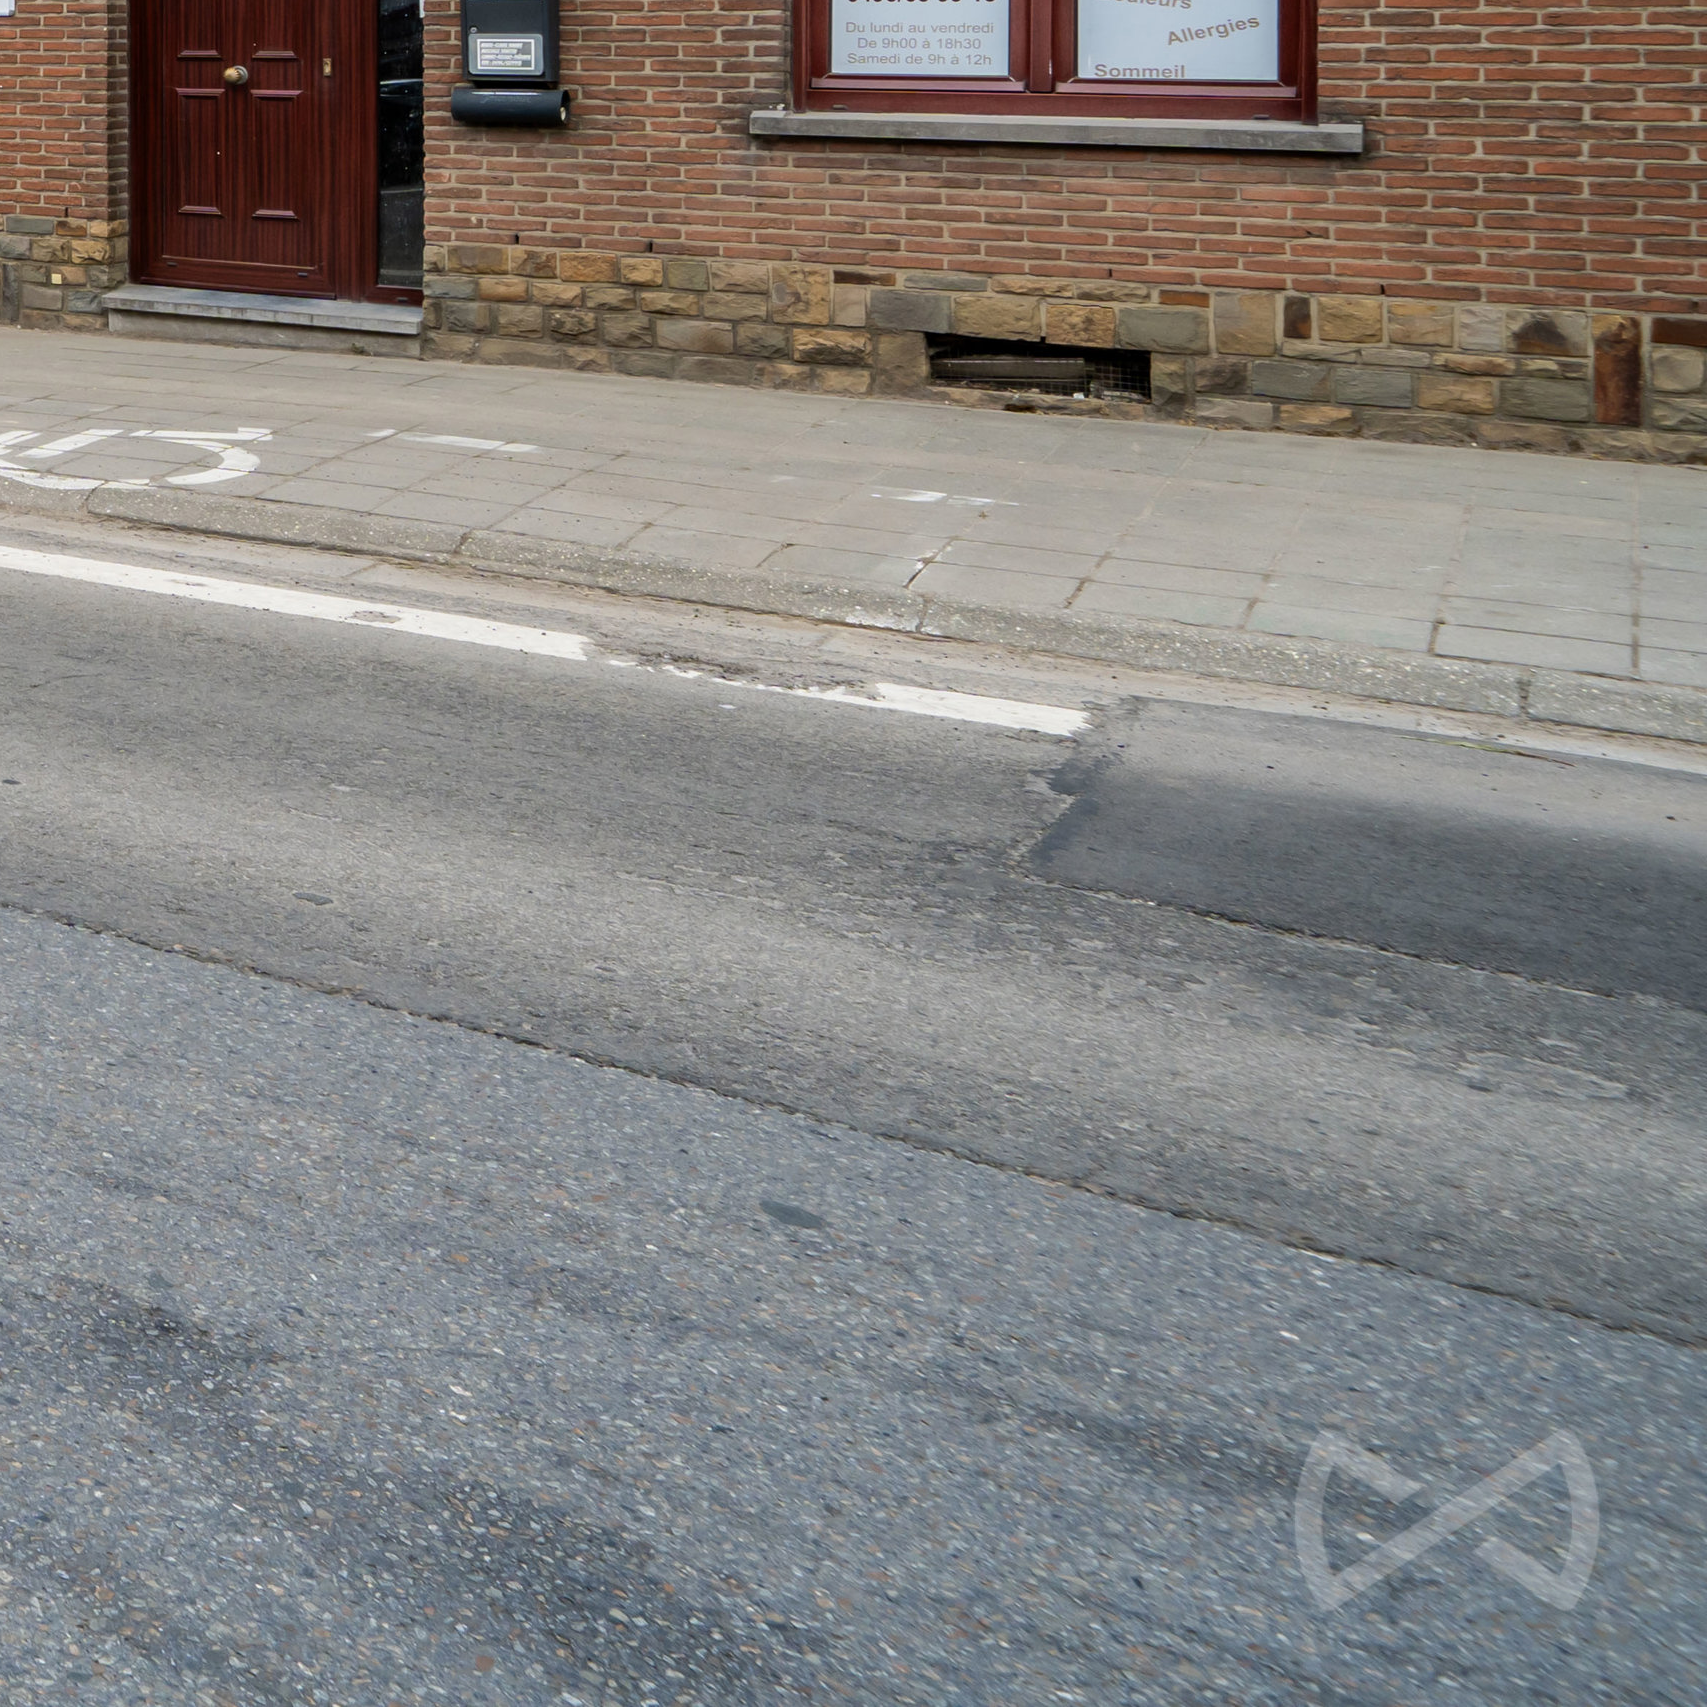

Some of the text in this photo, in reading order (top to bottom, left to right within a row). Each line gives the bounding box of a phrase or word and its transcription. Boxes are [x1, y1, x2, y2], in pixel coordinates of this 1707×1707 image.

[845, 21, 994, 34] Du lundi au vendredi
[1167, 17, 1260, 45] Allergies
[857, 37, 981, 50] De 9h00 à 18h30
[847, 52, 992, 66] Samedi de 9h à 12h
[1094, 63, 1186, 78] Sommeil
